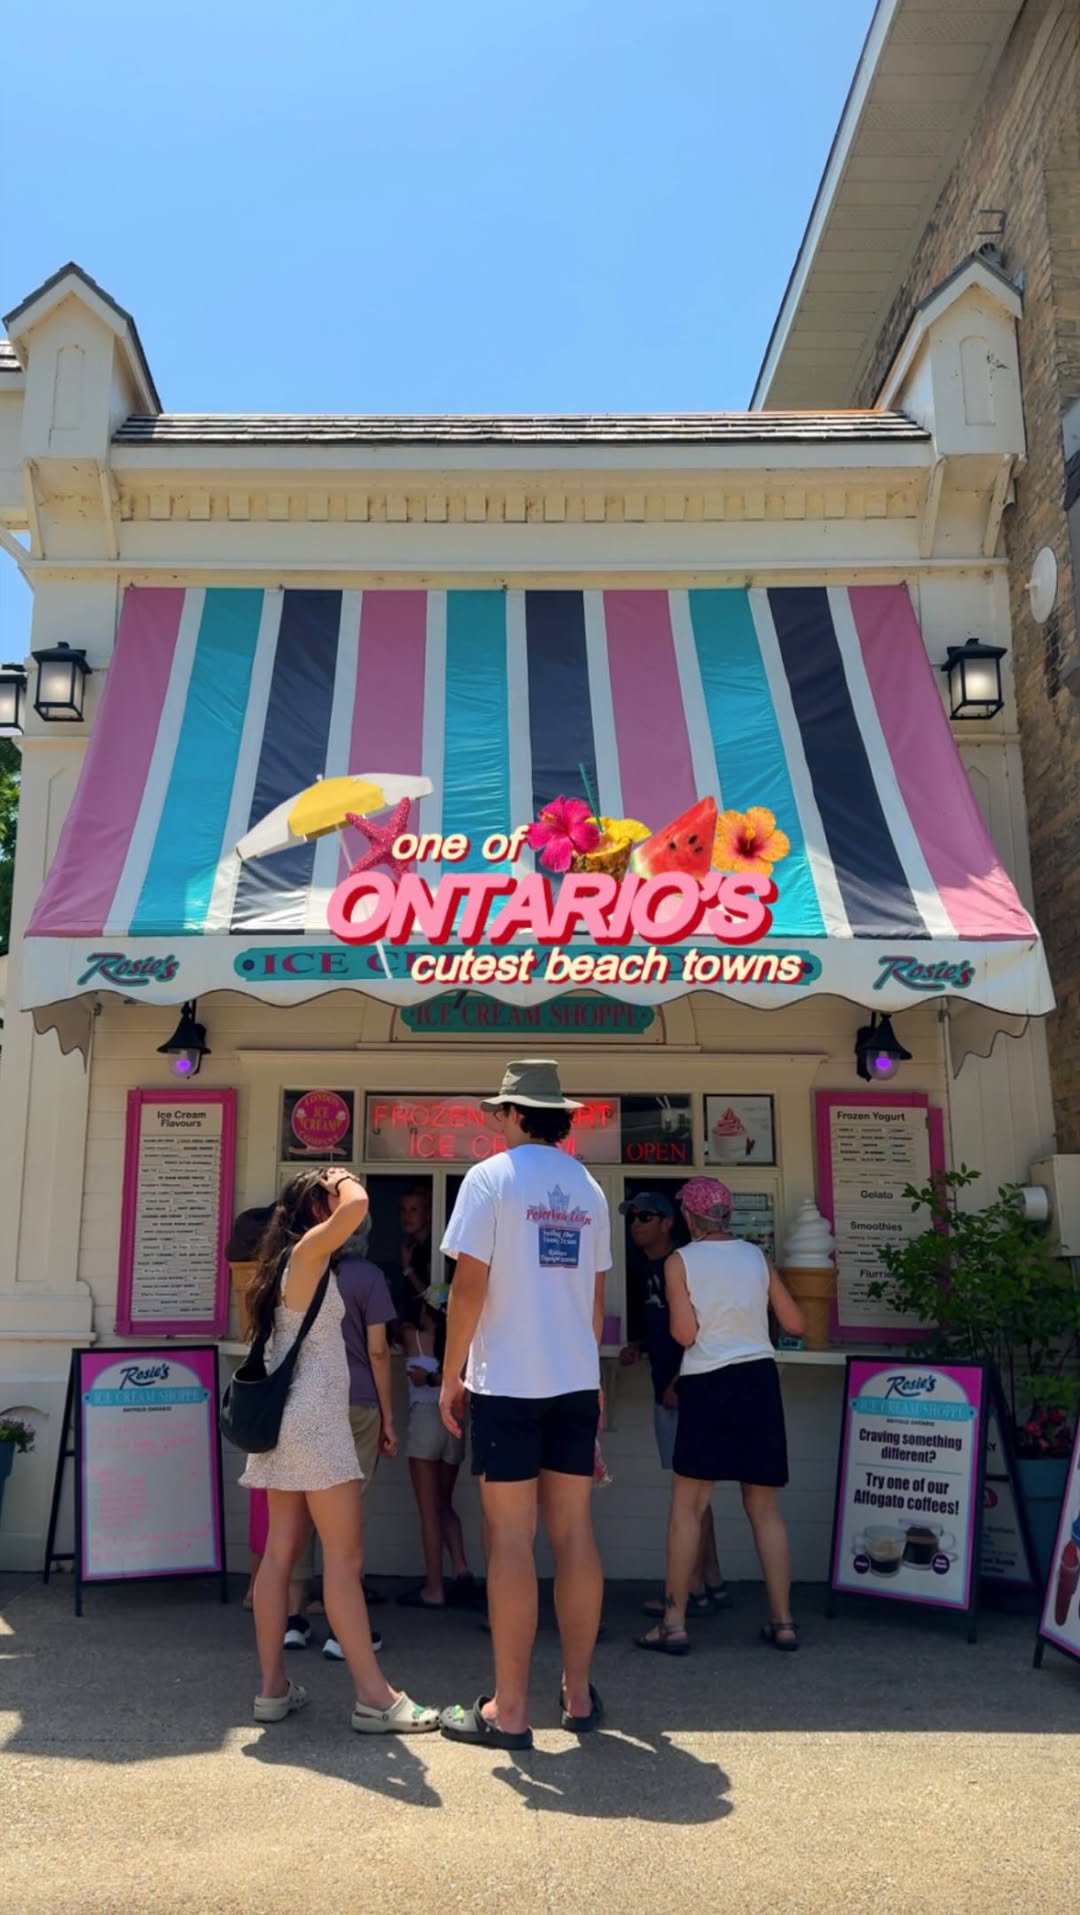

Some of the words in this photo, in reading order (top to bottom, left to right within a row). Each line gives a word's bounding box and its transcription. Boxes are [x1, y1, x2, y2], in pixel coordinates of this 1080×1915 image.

[77, 952, 180, 986] Rosie's
[263, 952, 349, 974] ICE
[872, 955, 976, 991] Rosie's
[416, 1003, 451, 1026] ICE
[461, 1003, 540, 1027] CREAM
[550, 1003, 639, 1027] SHOPPE
[157, 1111, 172, 1119] Ice
[174, 1111, 206, 1119] Cream
[372, 1104, 486, 1128] FROZEN
[837, 1111, 870, 1120] Frozen
[872, 1112, 905, 1122] Yogurt
[408, 1134, 455, 1158] ICE
[626, 1142, 687, 1162] OPEN
[860, 1190, 893, 1200] Gelato
[850, 1221, 903, 1231] Smoothies
[120, 1363, 170, 1390] Rosie's
[885, 1375, 936, 1400] Rosie's
[859, 1428, 900, 1445] Craving
[902, 1433, 962, 1451] something
[881, 1446, 936, 1464] different?
[866, 1472, 885, 1490] Try
[887, 1479, 909, 1491] one
[912, 1478, 924, 1492] of
[927, 1482, 949, 1495] our
[853, 1489, 905, 1509] Affogato
[907, 1496, 959, 1516] coffees!
